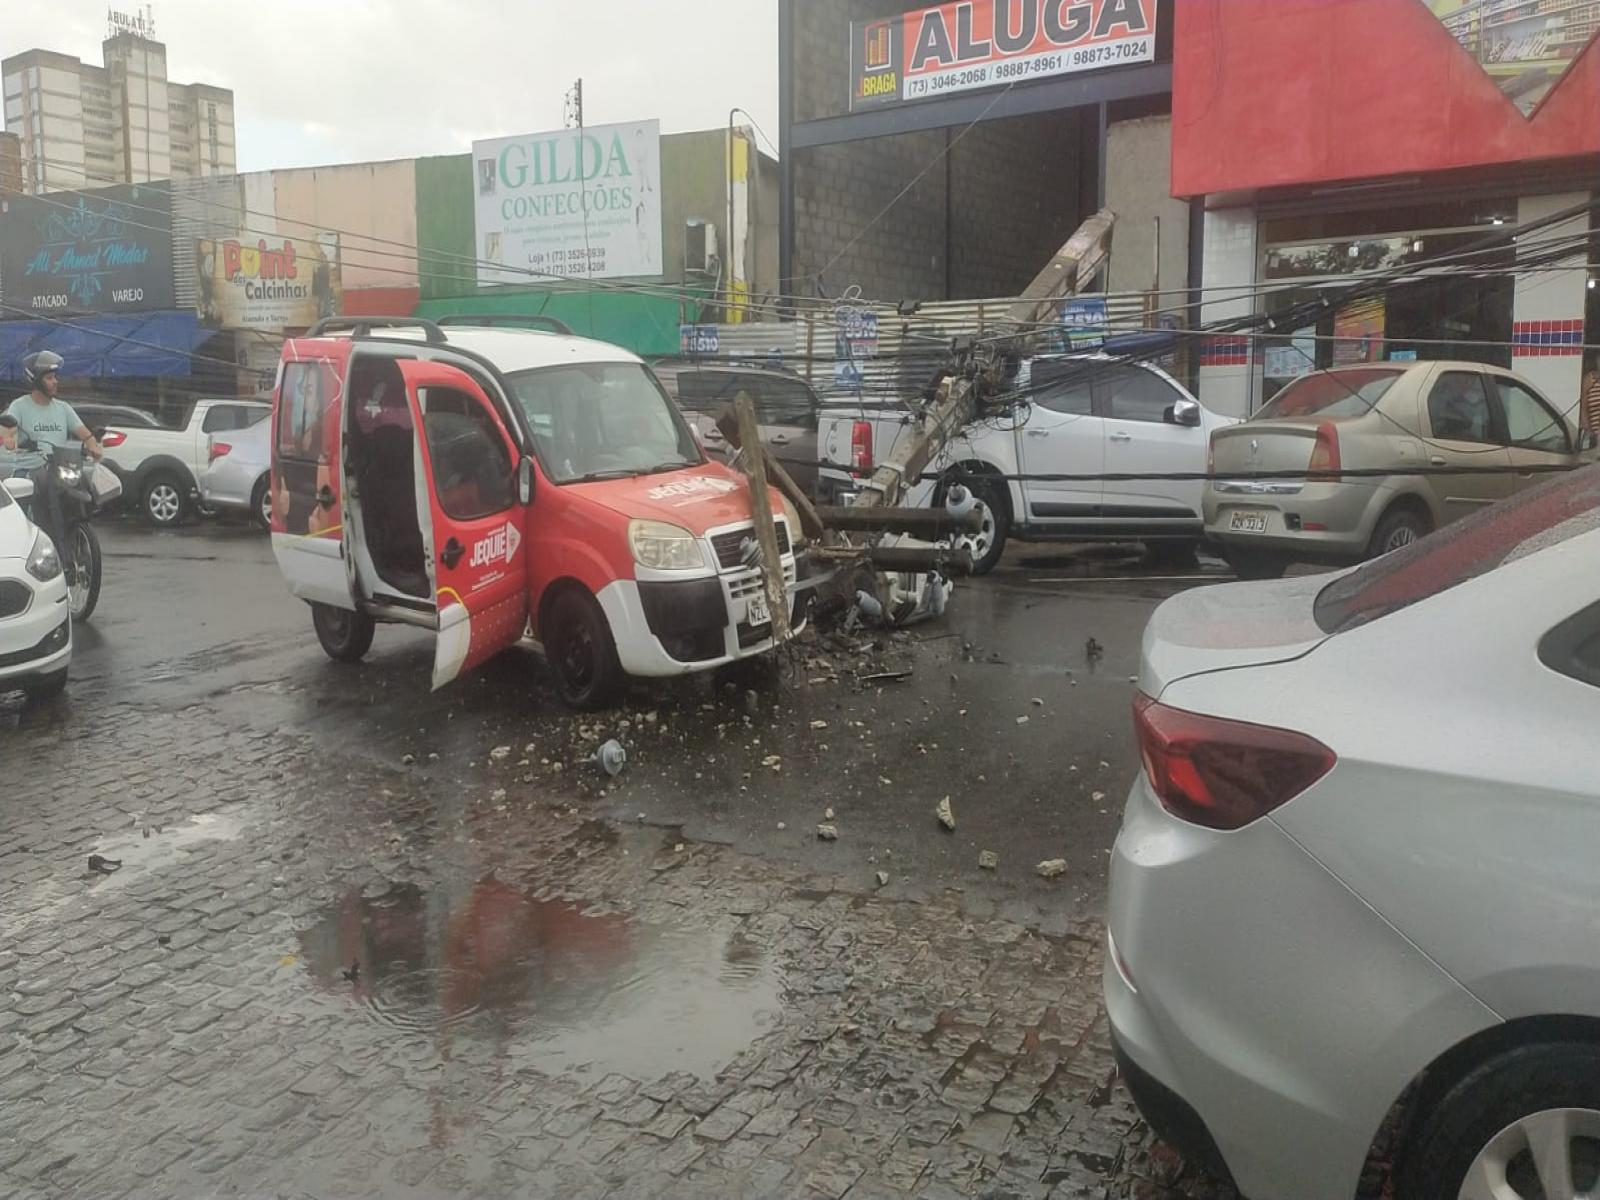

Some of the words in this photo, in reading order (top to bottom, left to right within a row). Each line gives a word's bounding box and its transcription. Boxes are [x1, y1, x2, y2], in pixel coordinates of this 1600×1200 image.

[910, 0, 1148, 72] ALUGA
[908, 79, 928, 96] (73)
[931, 68, 986, 90] 3046-2068
[996, 55, 1062, 78] 98887-8961
[1073, 40, 1147, 65] 98873-7024
[863, 72, 896, 96] BRAGA
[499, 130, 633, 189] GILDA
[501, 183, 632, 221] CONFECÇÕES
[223, 239, 298, 281] Point
[528, 252, 544, 264] Loja
[552, 250, 567, 264] (73)
[32, 294, 68, 308] ATACADO
[112, 288, 143, 302] VAREJO
[245, 280, 308, 300] Calcinhas
